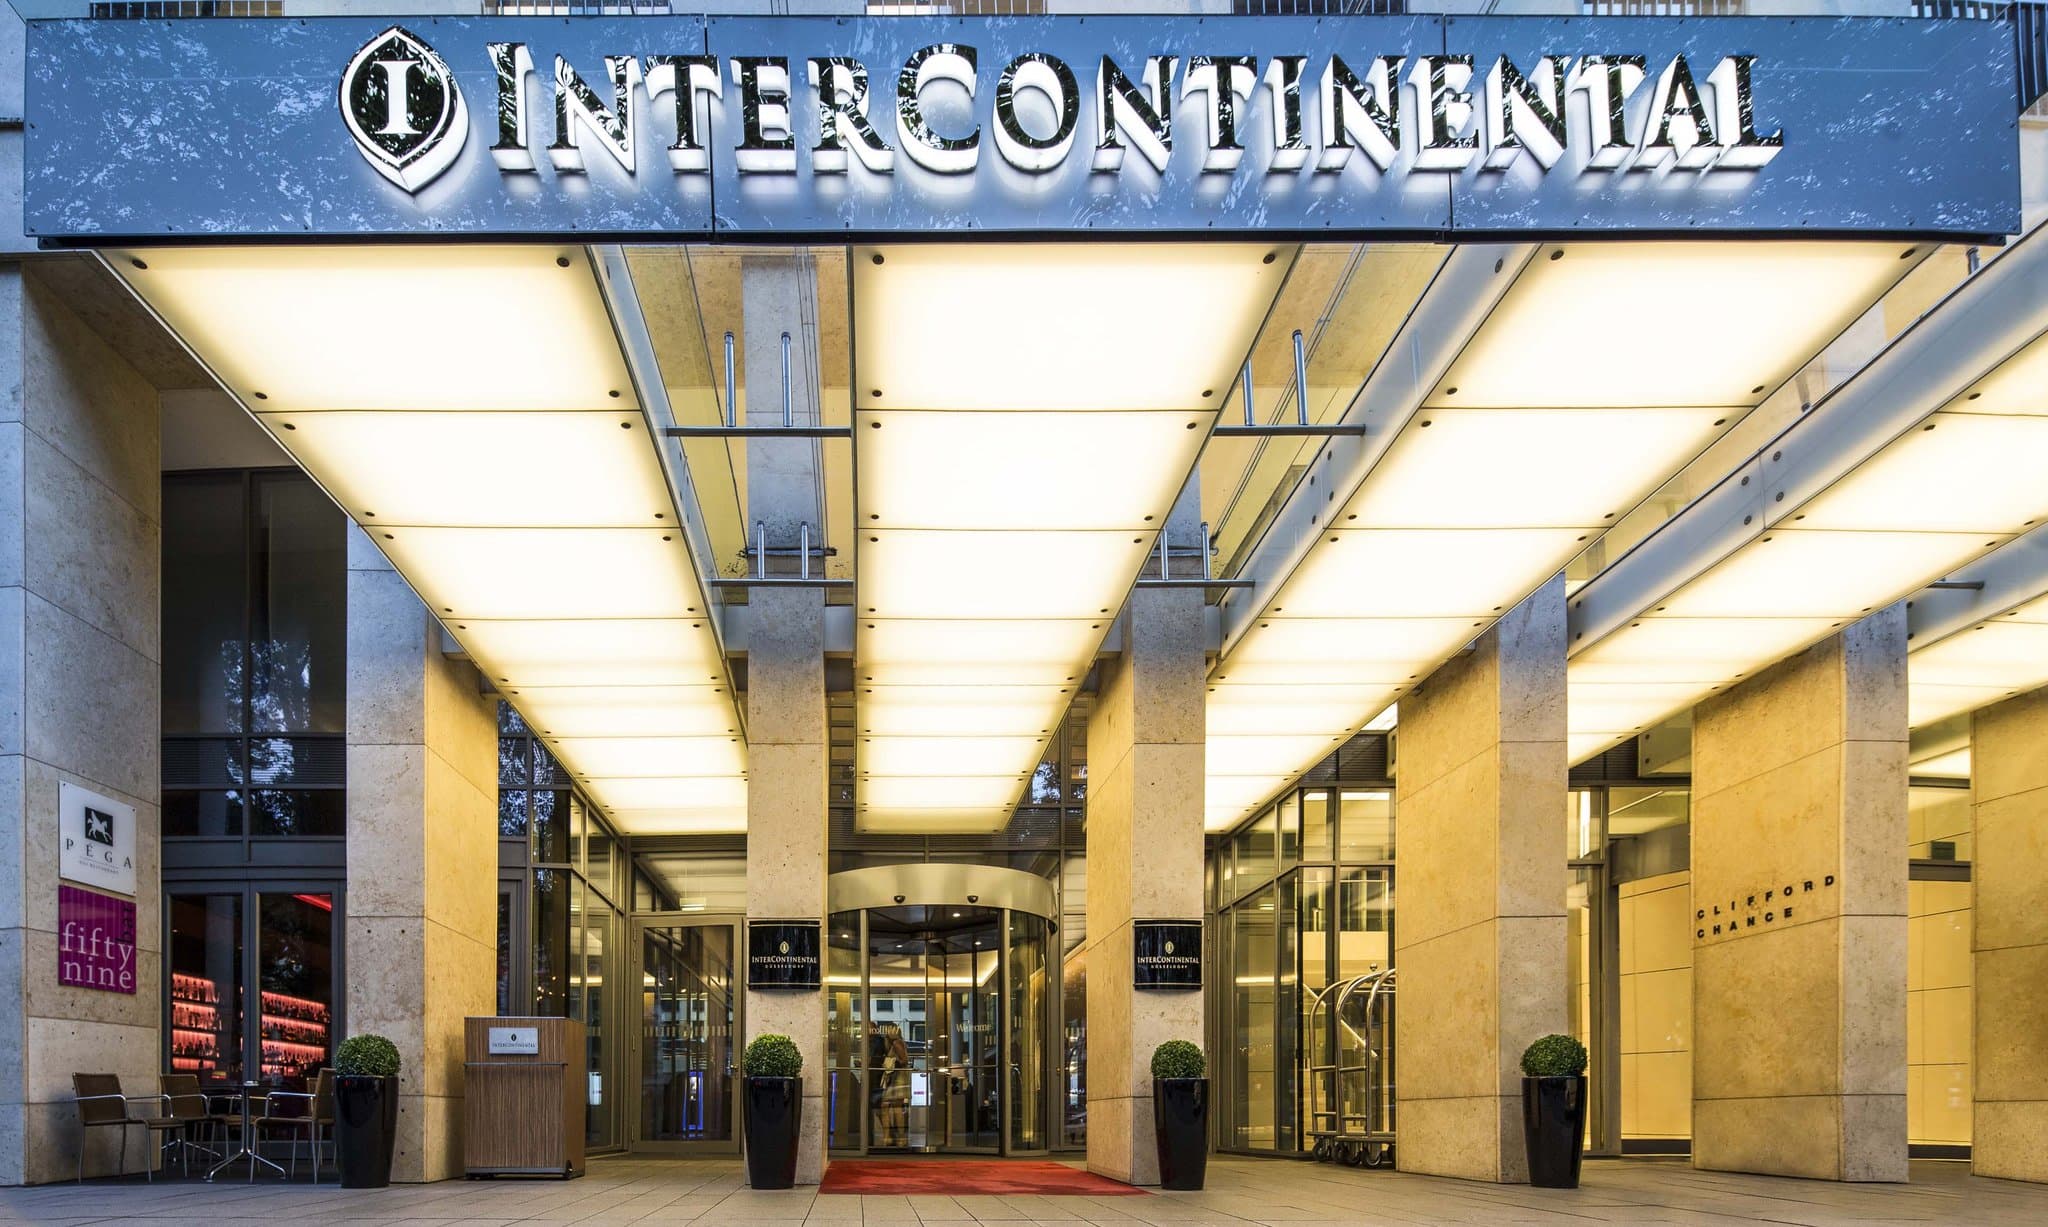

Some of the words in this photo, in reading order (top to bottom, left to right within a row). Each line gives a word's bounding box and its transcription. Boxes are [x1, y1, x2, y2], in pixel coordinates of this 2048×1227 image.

[486, 42, 1784, 172] INTERCONTINENTAL
[1696, 875, 1835, 920] CLIFFORD
[1696, 907, 1793, 938] CHANCE
[60, 921, 134, 970] fifty
[63, 957, 132, 989] nine
